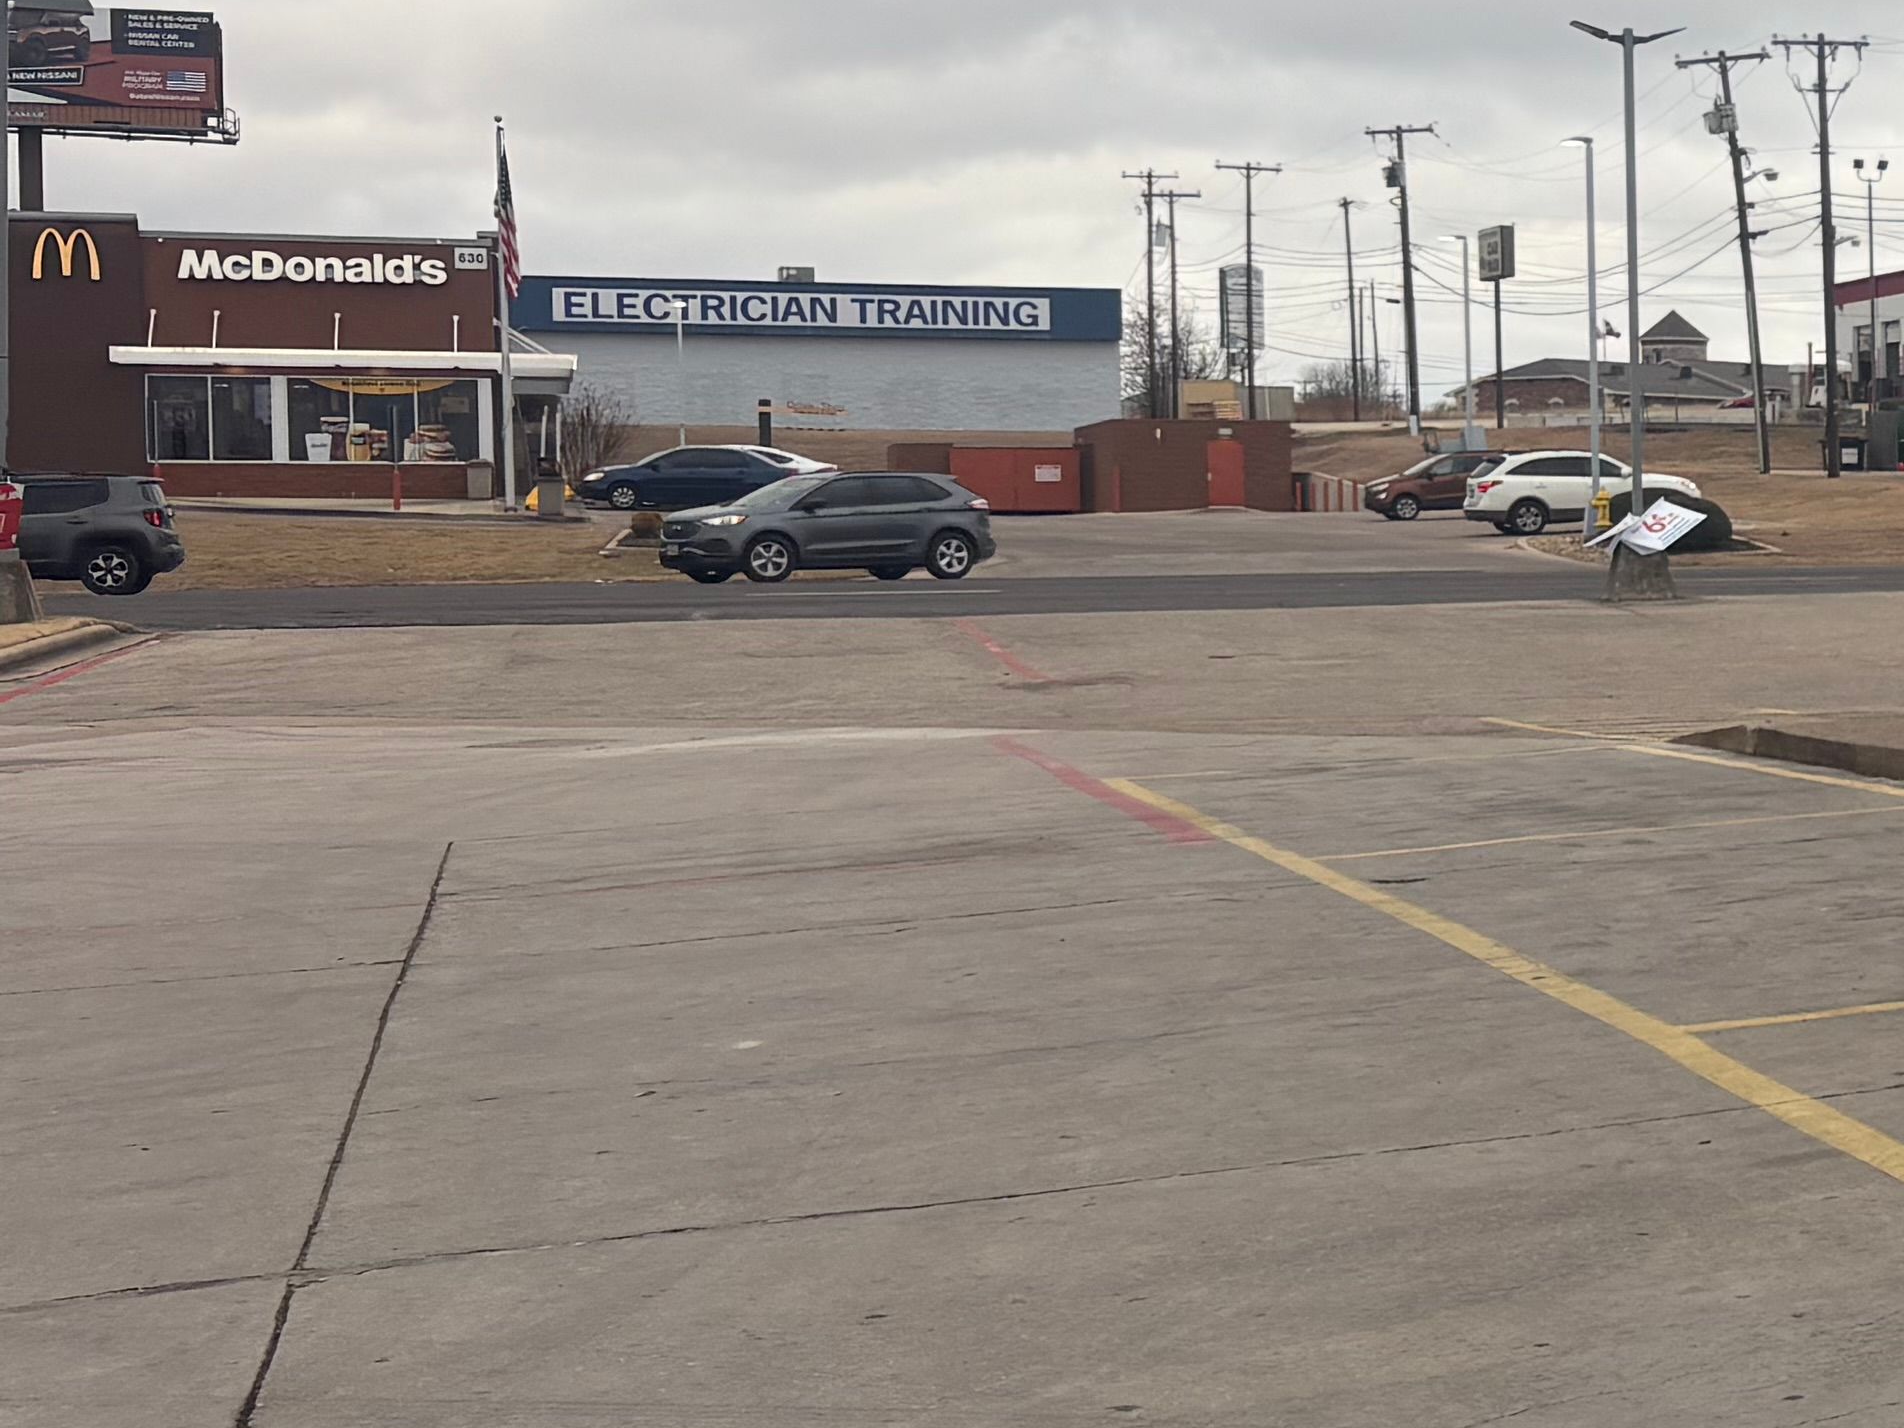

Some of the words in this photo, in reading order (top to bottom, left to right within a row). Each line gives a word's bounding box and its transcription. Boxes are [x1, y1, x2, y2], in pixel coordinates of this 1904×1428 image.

[178, 249, 448, 285] McDonald's
[458, 252, 484, 264] 630
[563, 291, 837, 324] ELECTRICIAN
[852, 297, 1040, 328] TRAINING
